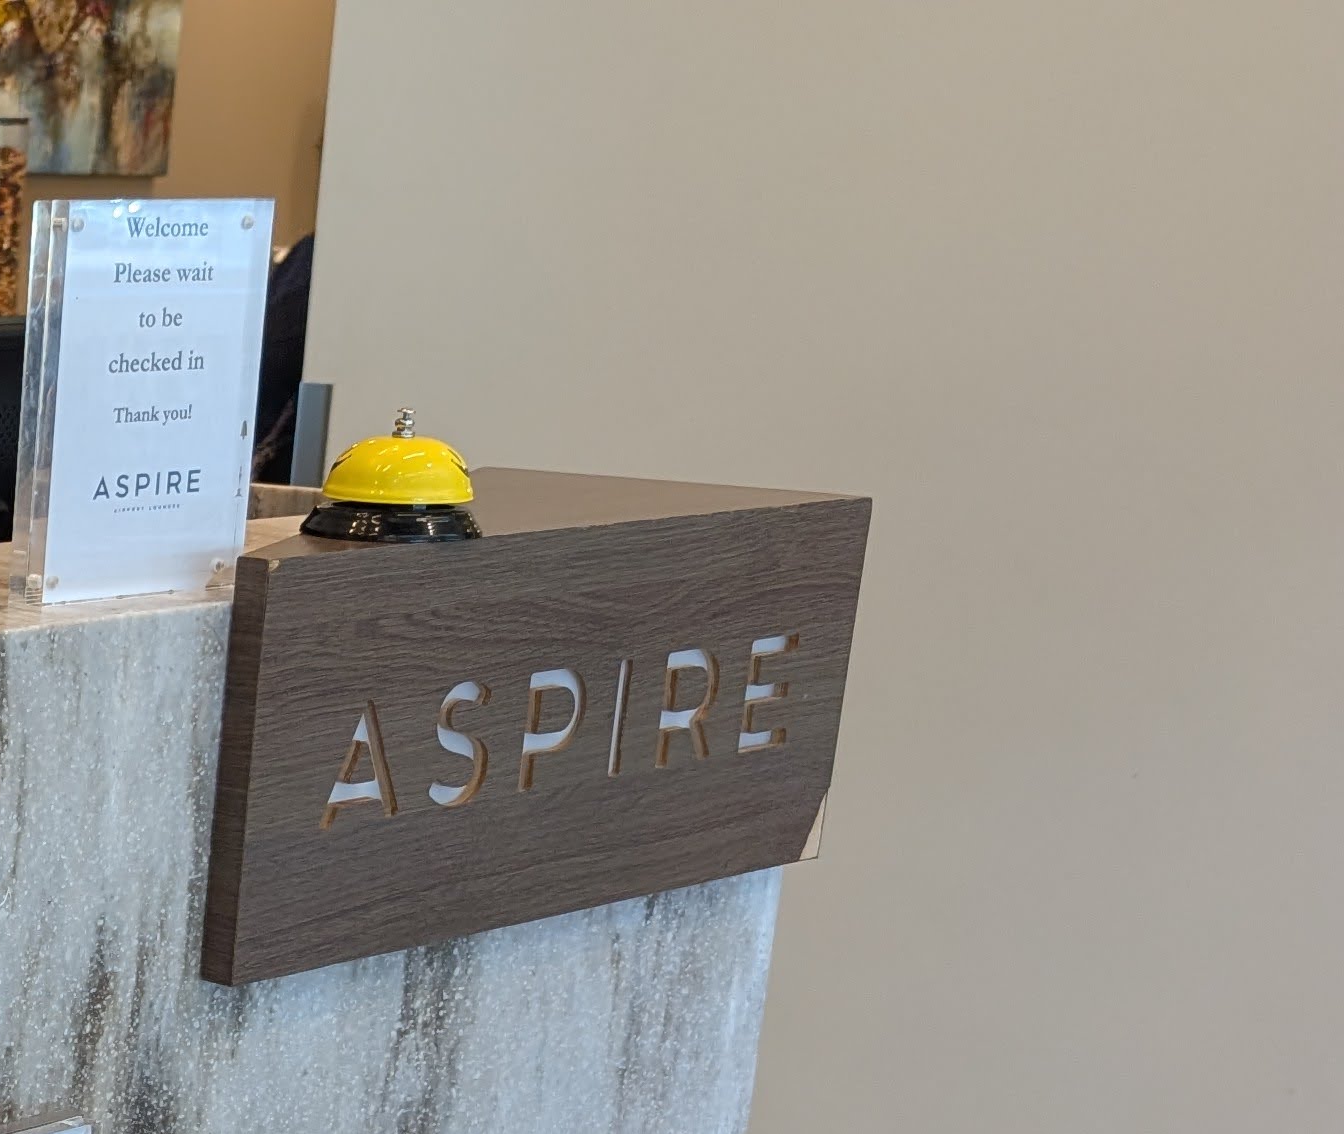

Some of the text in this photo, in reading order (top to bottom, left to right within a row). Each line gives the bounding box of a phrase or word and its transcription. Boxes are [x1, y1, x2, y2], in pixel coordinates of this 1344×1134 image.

[127, 216, 209, 238] Welcome
[113, 261, 214, 283] Please wait
[139, 306, 183, 328] to be
[108, 350, 205, 374] checked in
[113, 404, 193, 426] Thank you!
[92, 469, 201, 501] ASPIRE
[317, 632, 801, 830] ASPIRE
